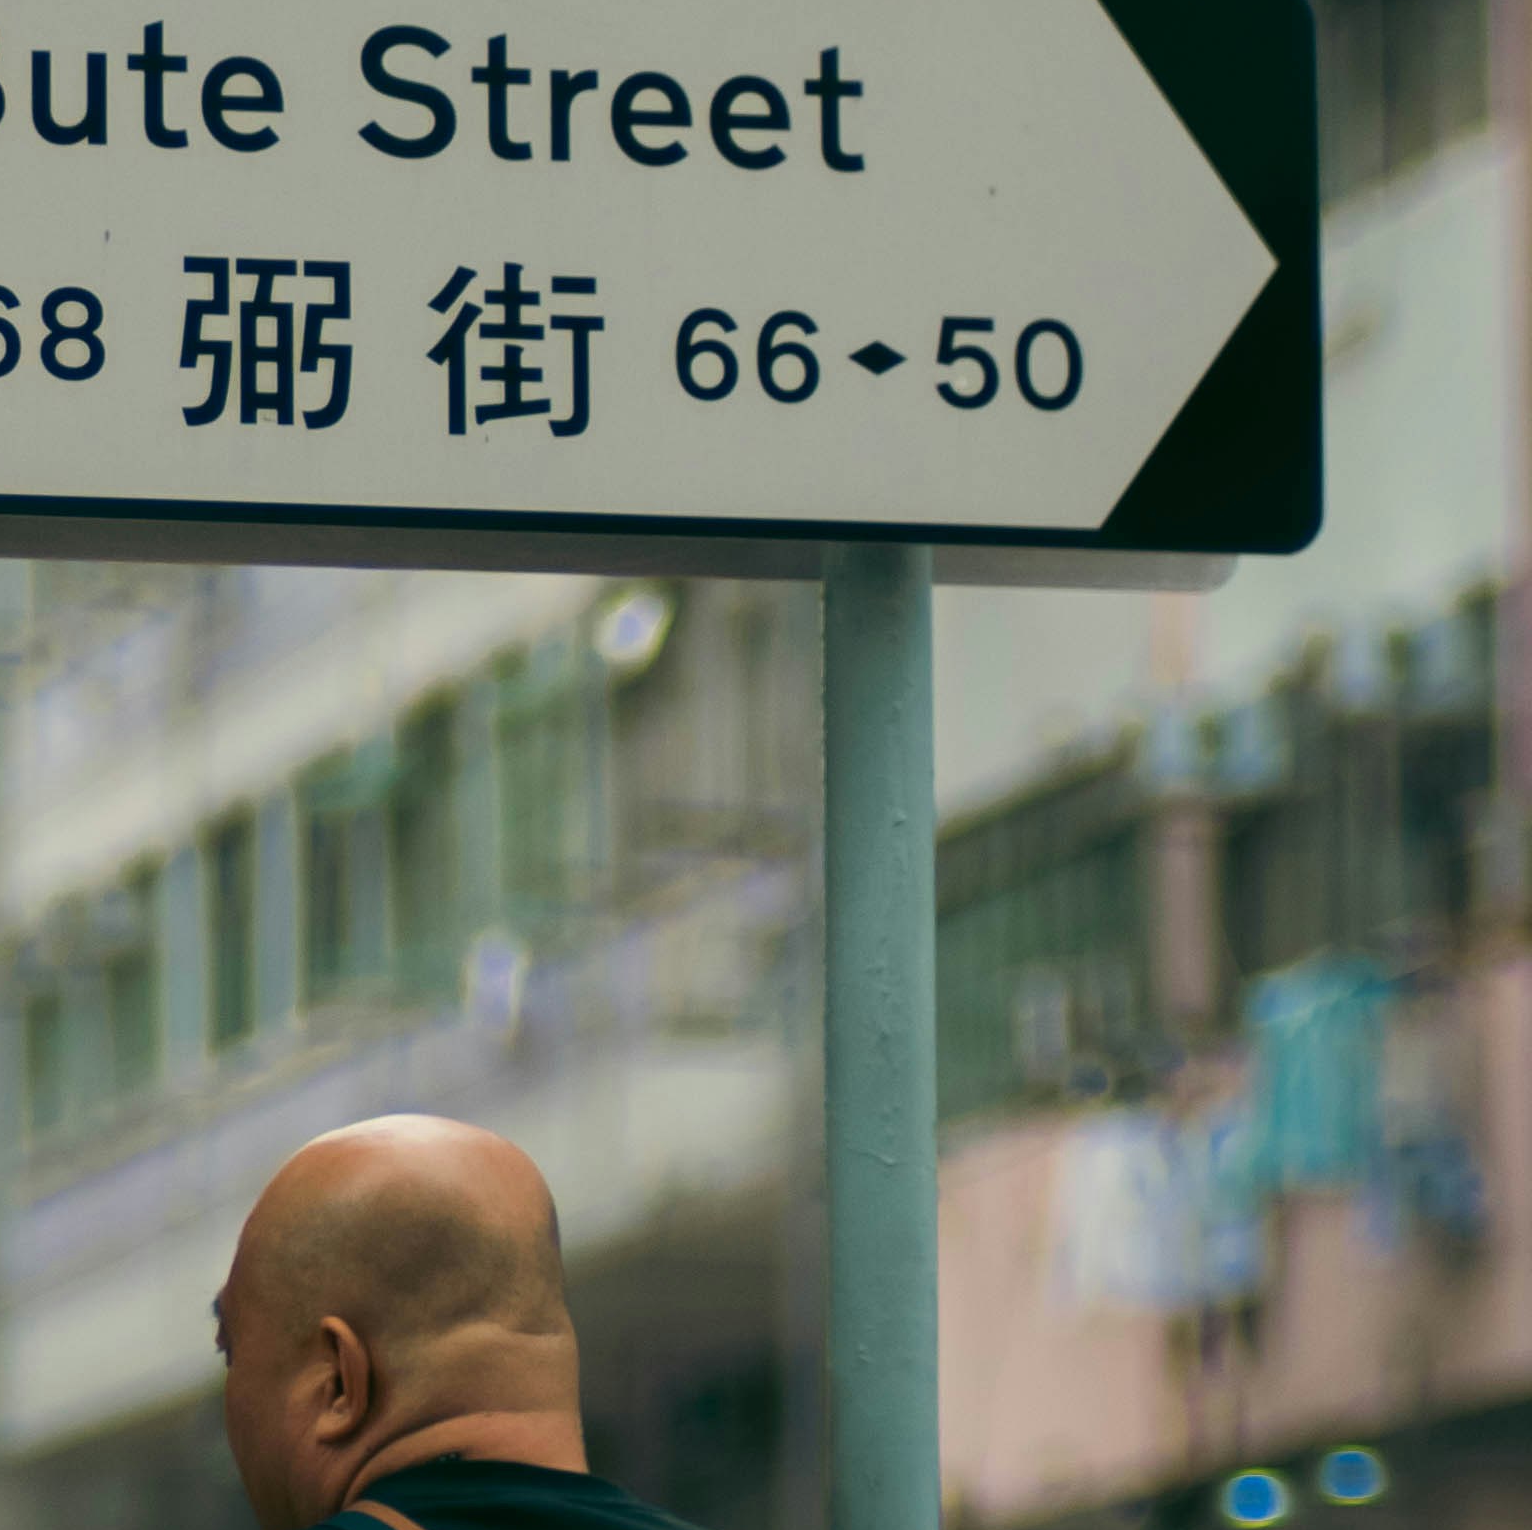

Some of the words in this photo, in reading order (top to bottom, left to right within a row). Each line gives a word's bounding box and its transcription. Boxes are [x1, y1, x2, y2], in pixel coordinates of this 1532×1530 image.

[356, 23, 866, 175] Street
[674, 306, 822, 406] 66
[934, 314, 1085, 413] 50
